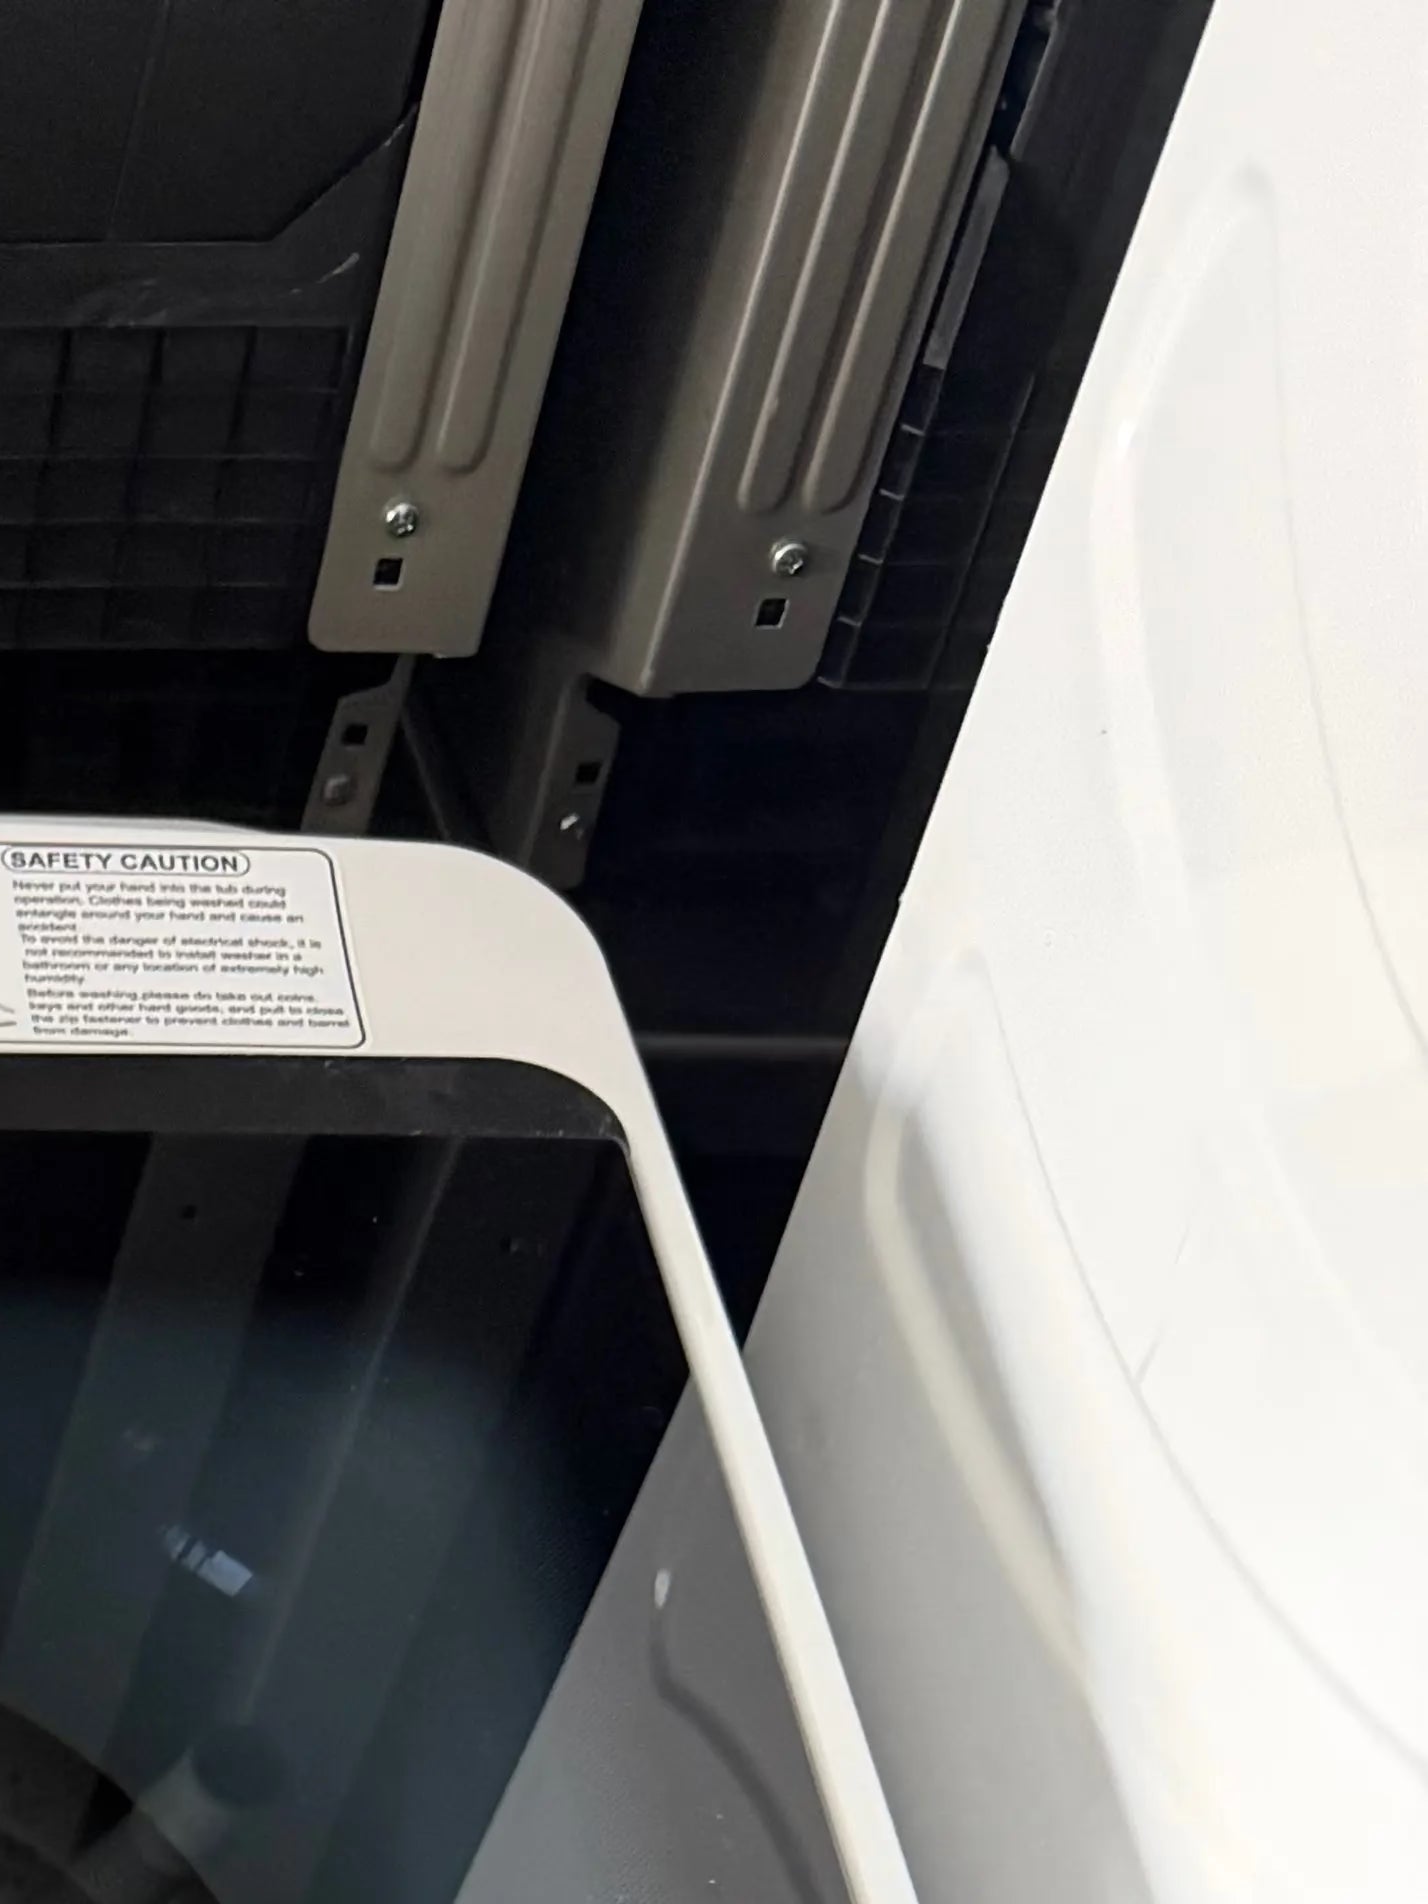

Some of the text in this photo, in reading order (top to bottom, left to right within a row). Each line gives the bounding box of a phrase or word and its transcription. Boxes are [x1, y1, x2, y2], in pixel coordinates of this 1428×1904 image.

[10, 852, 238, 872] SAFETY CAUTION
[86, 882, 115, 894] your
[242, 885, 286, 898] during
